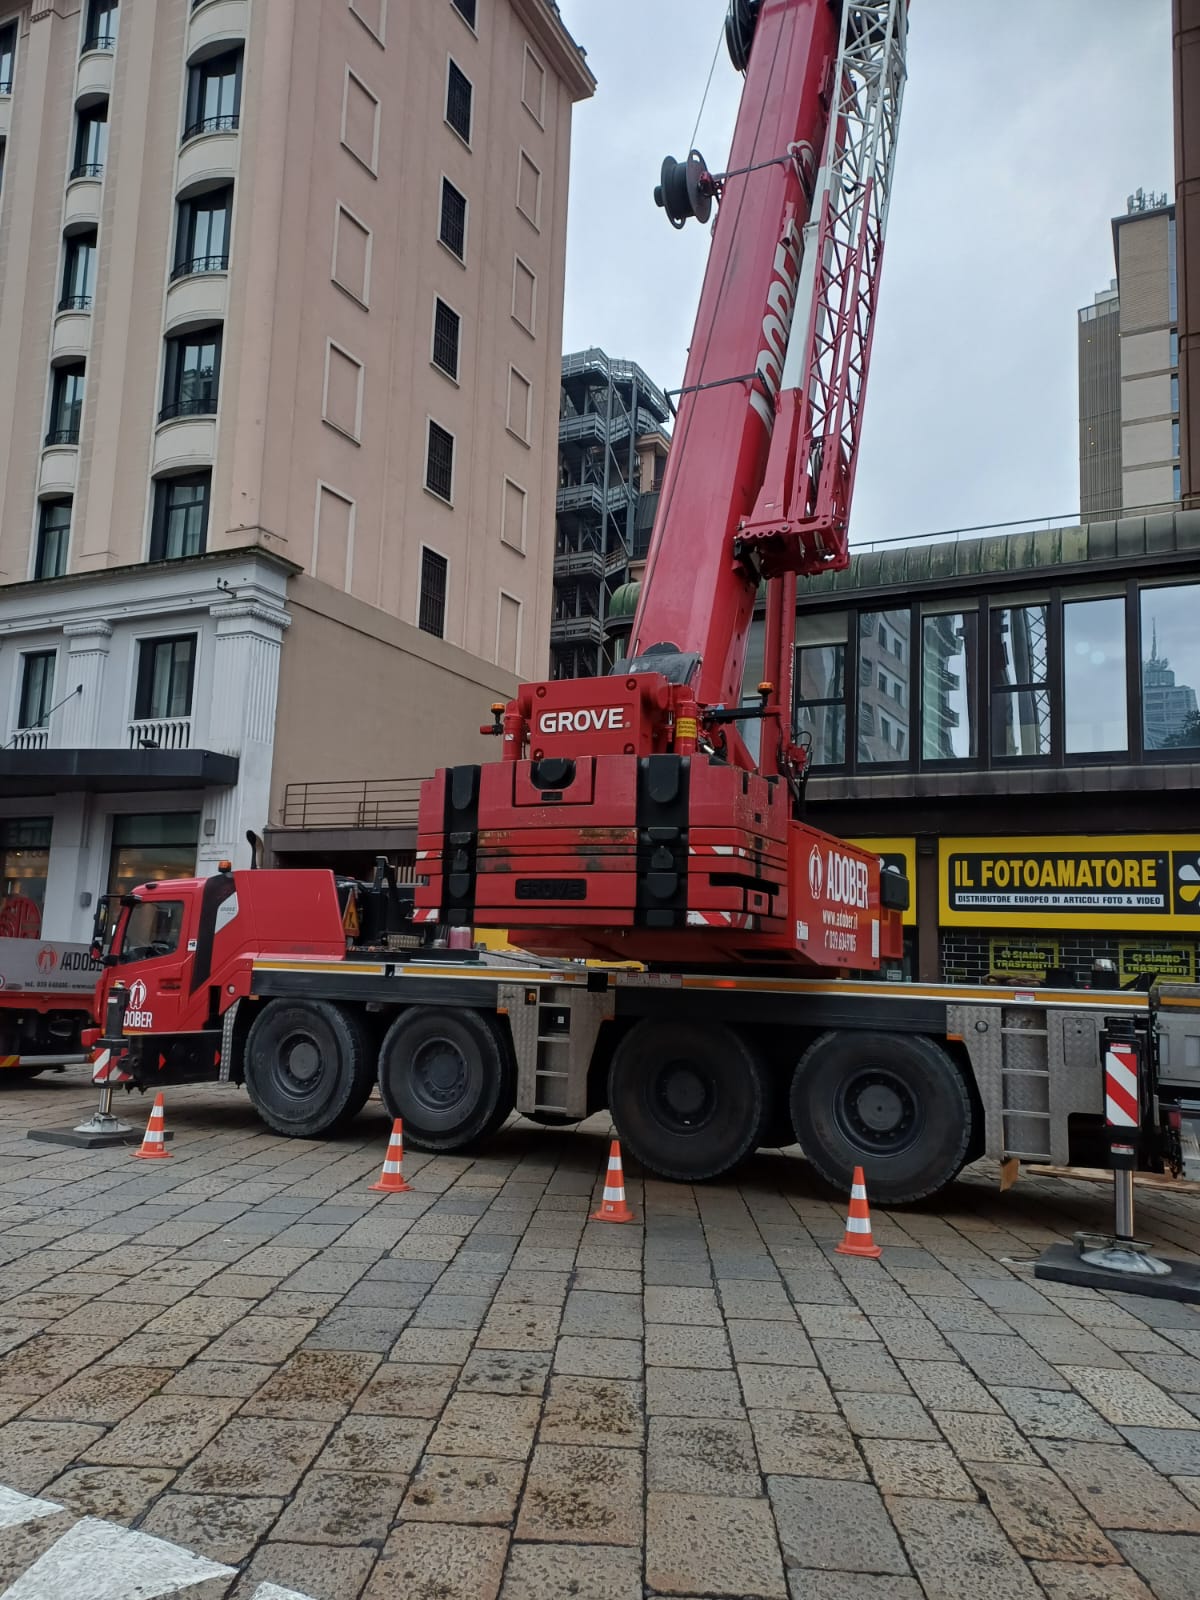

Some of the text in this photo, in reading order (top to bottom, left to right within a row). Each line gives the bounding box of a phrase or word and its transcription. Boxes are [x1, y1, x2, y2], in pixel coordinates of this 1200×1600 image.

[539, 707, 625, 733] GROVE
[826, 850, 869, 909] ADOBER
[954, 858, 1157, 888] IL FOTOAMATORE
[958, 895, 1161, 905] DISTRIBUTORE EUROPEO DI ARTICOLI FOTO & VIDEO
[122, 1010, 153, 1028] DOBER
